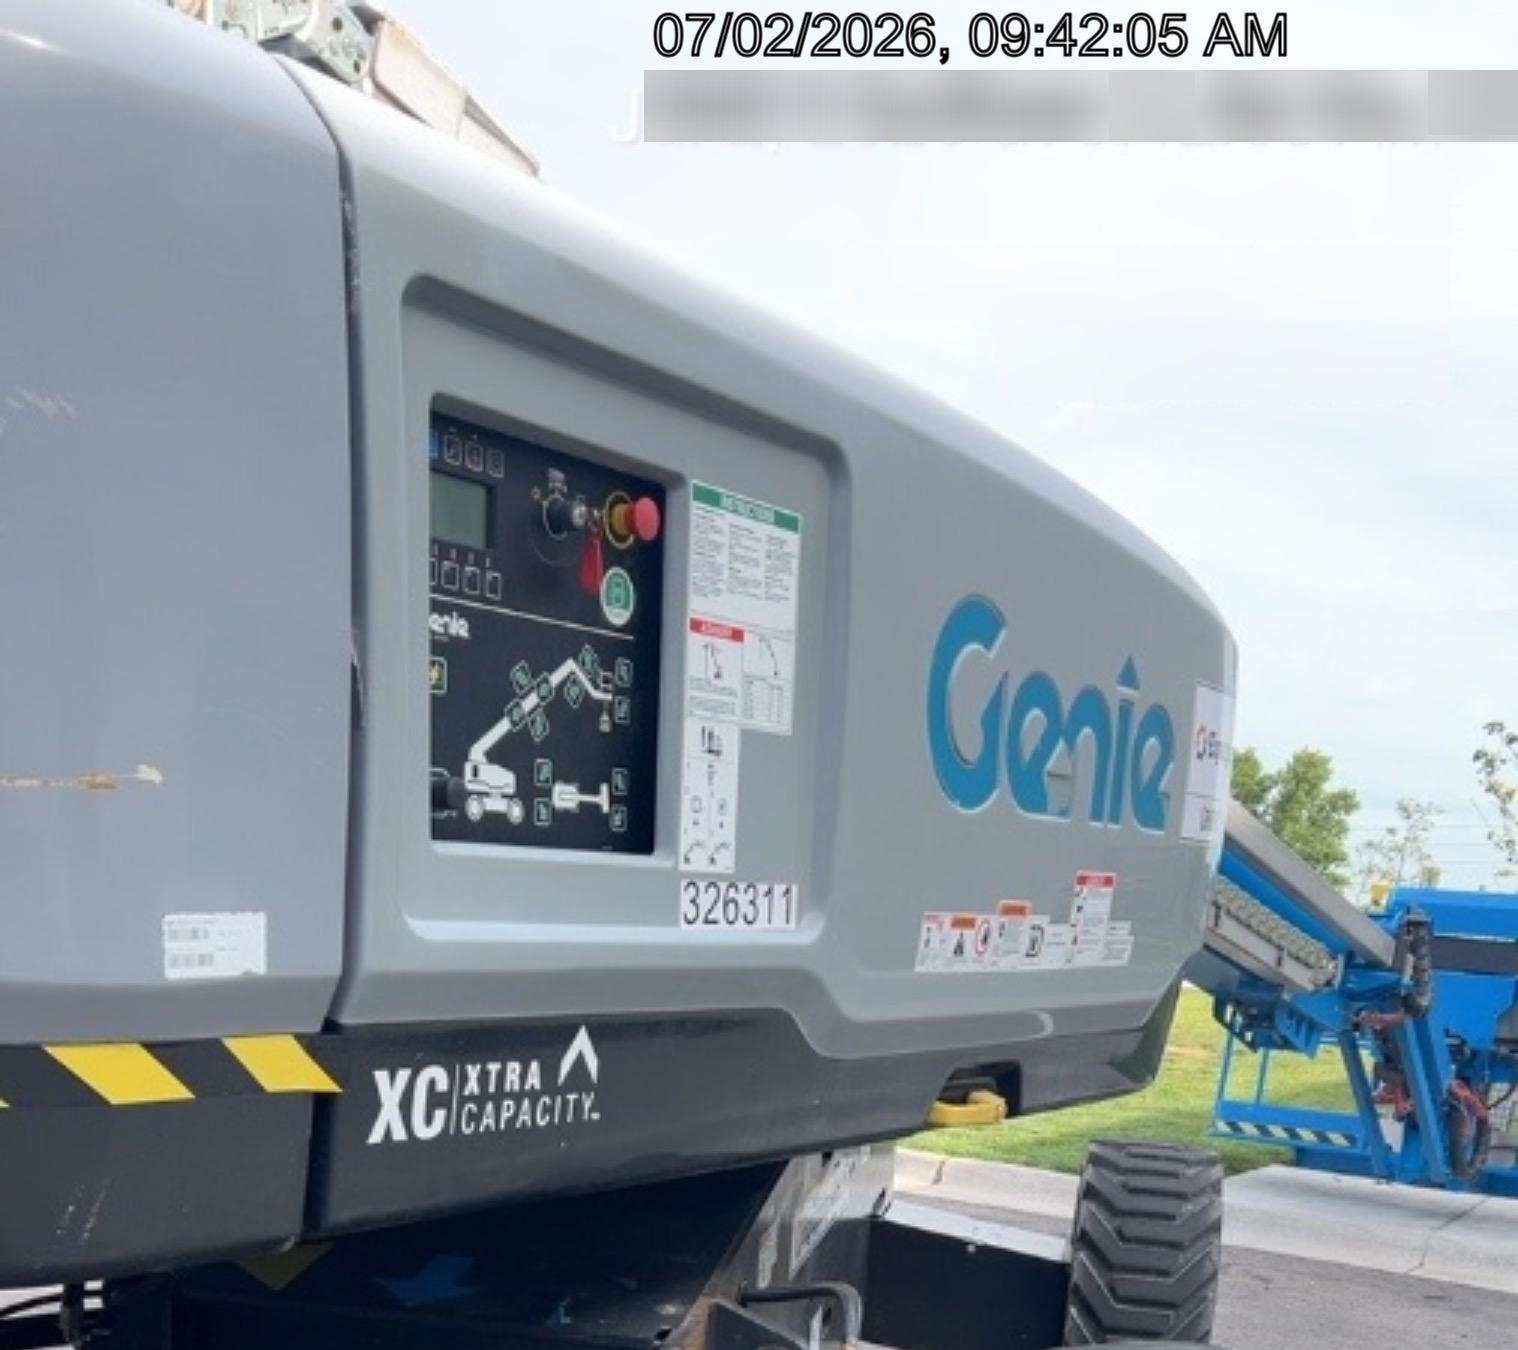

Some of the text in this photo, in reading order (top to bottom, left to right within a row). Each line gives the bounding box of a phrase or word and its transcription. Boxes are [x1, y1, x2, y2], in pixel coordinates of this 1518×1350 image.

[430, 611, 470, 639] enie
[927, 595, 1174, 834] Genie
[682, 880, 793, 926] 326311
[463, 1059, 542, 1096] XTRA
[366, 1064, 449, 1145] XC
